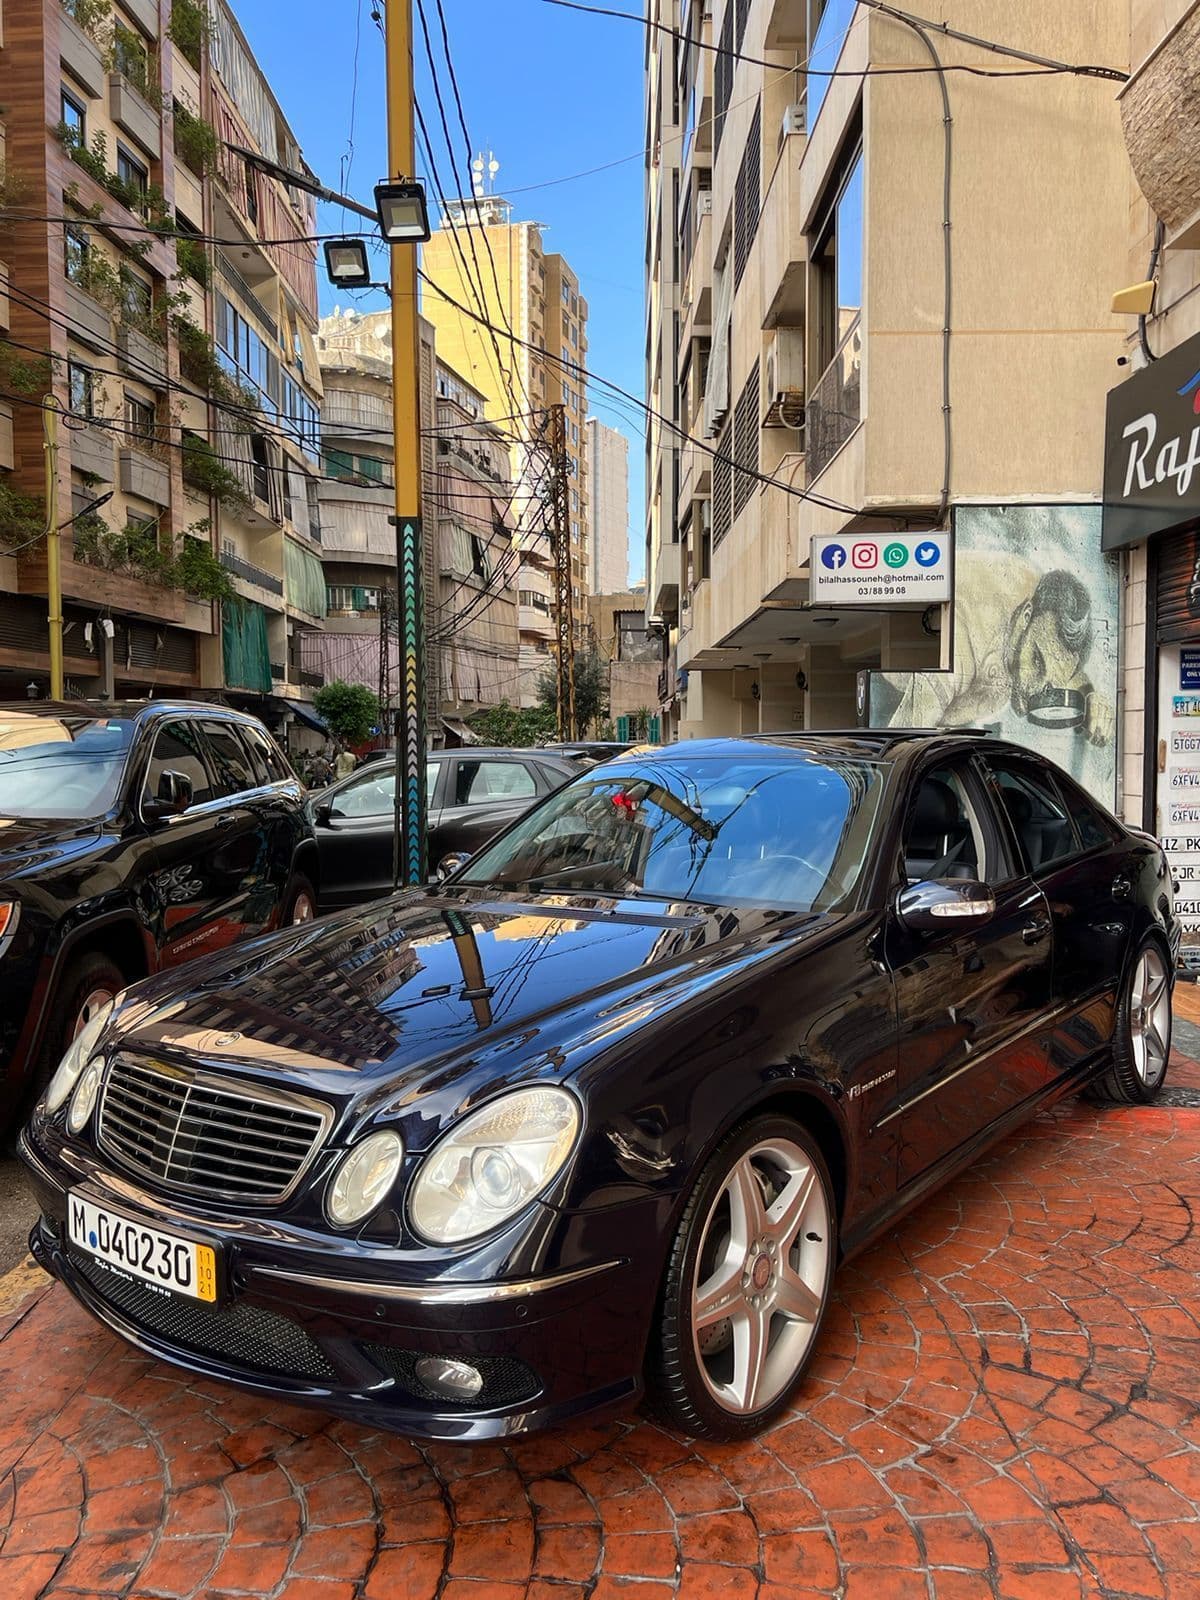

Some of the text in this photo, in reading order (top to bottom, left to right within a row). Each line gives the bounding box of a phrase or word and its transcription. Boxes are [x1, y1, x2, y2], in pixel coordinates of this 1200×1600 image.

[818, 574, 945, 584] bilalhassouneh@hotmail.com
[884, 587, 894, 595] 99
[896, 586, 906, 595] 08
[1179, 867, 1195, 879] JR
[73, 1200, 192, 1288] M 040230
